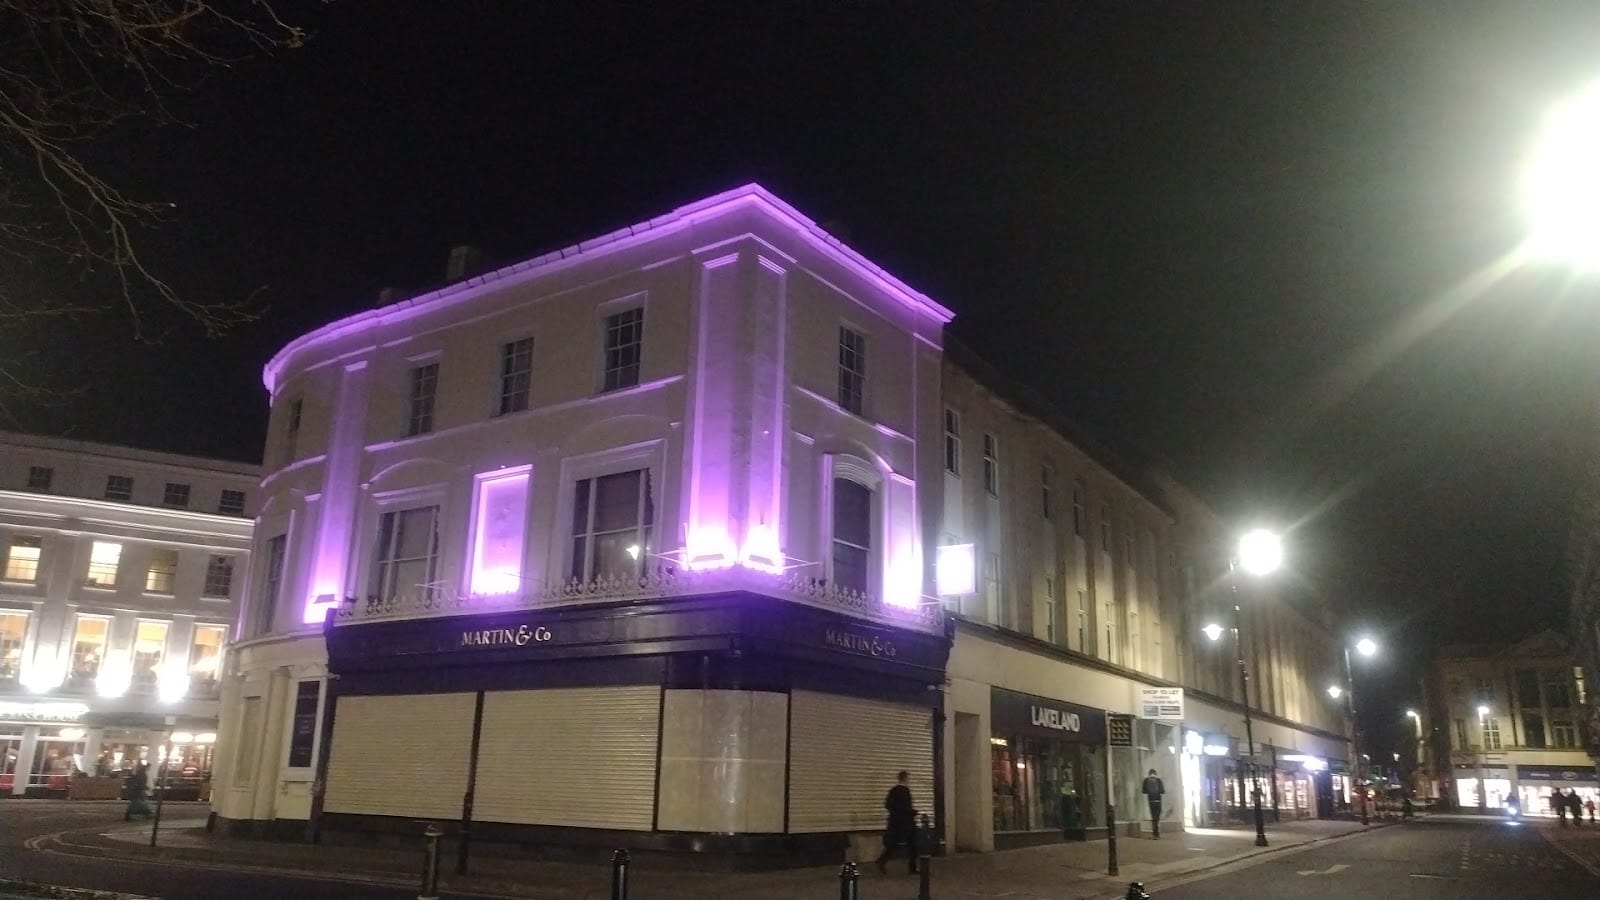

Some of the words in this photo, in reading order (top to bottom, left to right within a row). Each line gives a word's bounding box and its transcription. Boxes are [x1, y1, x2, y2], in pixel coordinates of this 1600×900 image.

[461, 629, 515, 646] MARTIN
[515, 624, 533, 646] &
[535, 626, 552, 642] Co
[825, 629, 870, 651] MARTIN
[871, 636, 883, 656] &
[1031, 705, 1080, 733] LAKELAND
